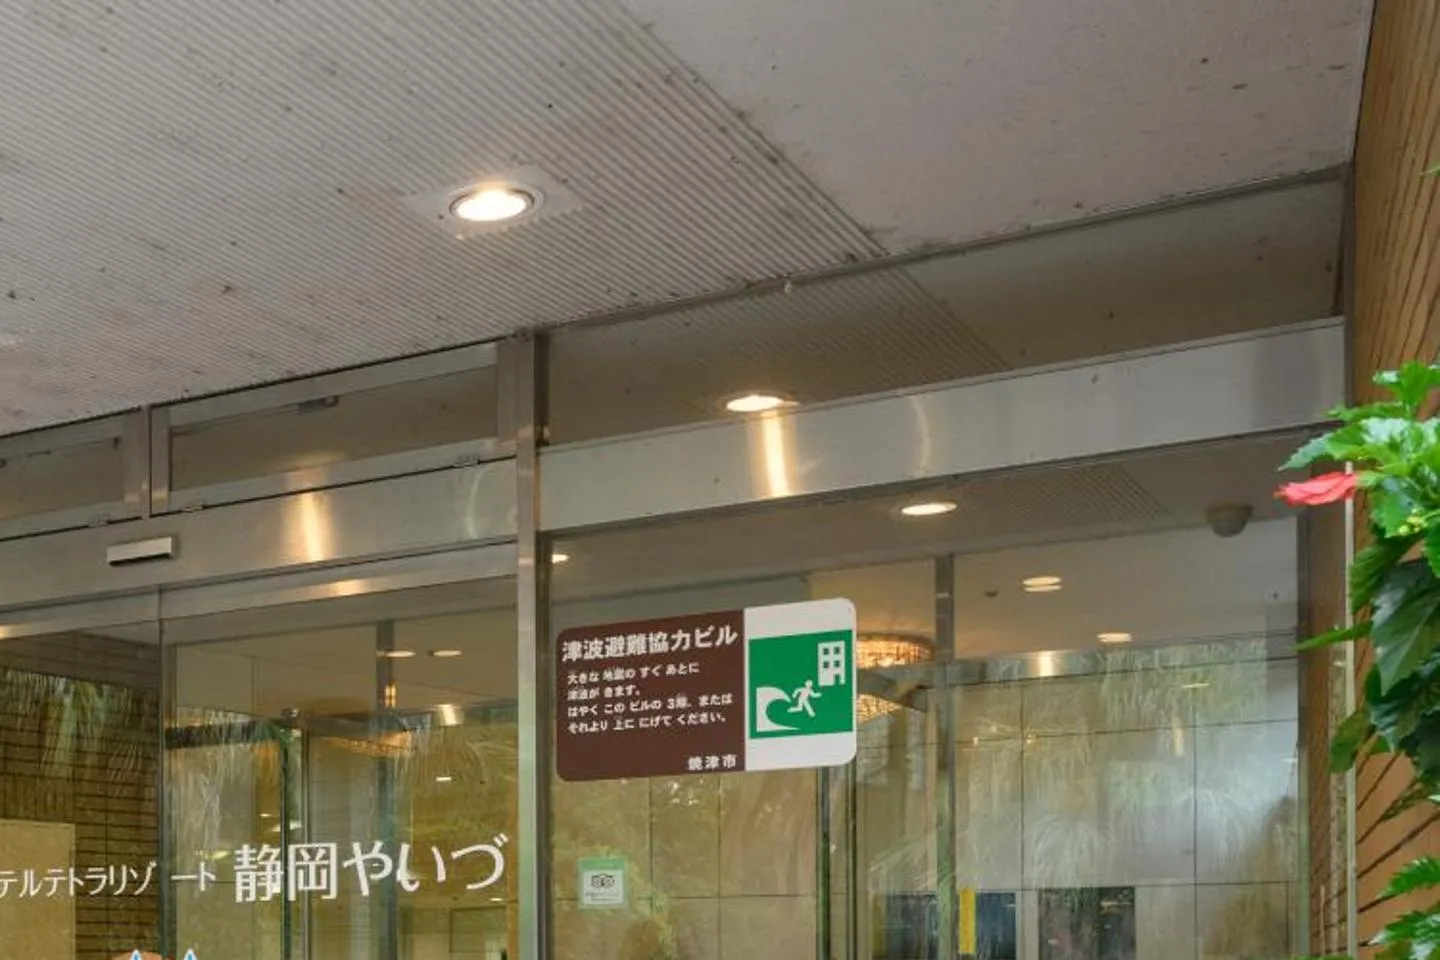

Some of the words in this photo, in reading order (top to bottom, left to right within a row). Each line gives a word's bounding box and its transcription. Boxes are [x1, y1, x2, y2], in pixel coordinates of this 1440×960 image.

[562, 625, 738, 662] 津波避難協力ビル
[567, 705, 599, 718] はやく
[604, 703, 625, 715] この
[698, 693, 733, 707] または
[613, 718, 635, 731] 上に
[639, 715, 673, 728] にげて
[687, 754, 737, 771] 焼津市
[233, 832, 509, 903] 静岡やいづ
